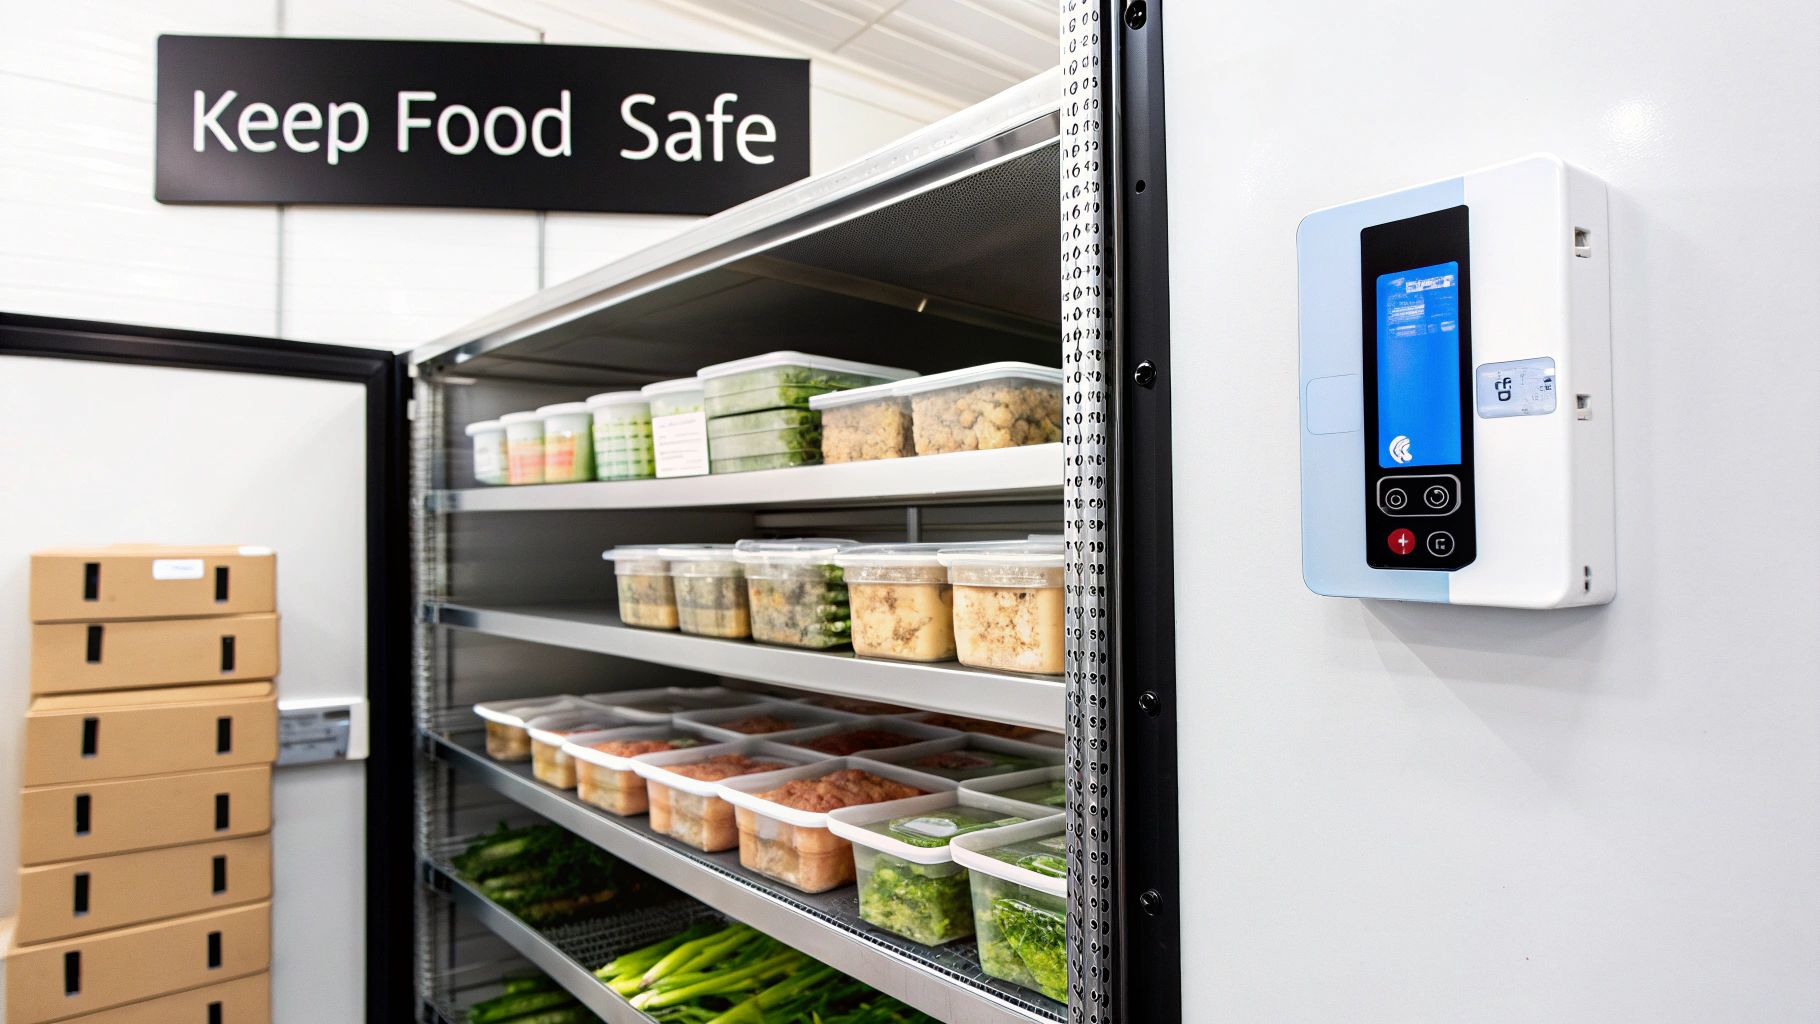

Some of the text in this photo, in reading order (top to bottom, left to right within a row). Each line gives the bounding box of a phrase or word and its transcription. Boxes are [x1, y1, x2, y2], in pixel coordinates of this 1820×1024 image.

[192, 89, 777, 166] Keep Food Safe
